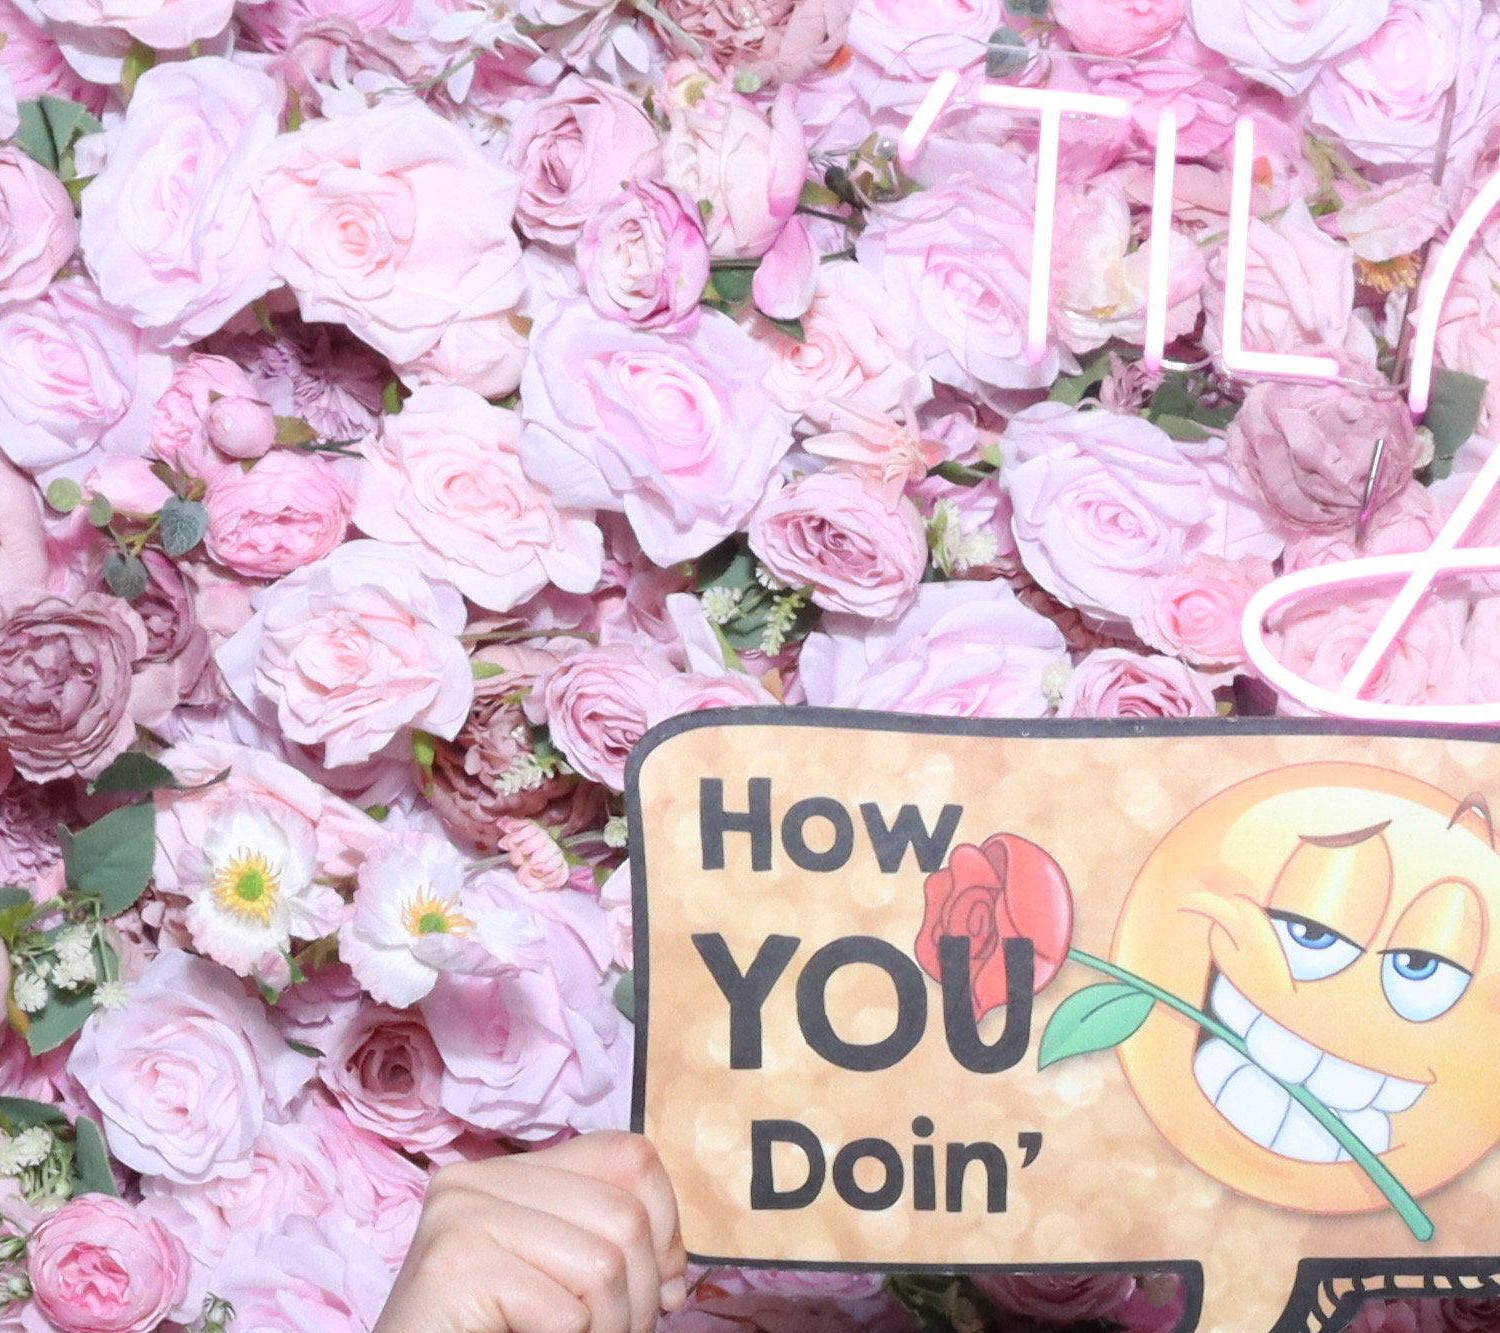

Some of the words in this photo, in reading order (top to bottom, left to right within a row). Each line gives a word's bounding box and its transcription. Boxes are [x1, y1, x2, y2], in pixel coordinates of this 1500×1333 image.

[698, 776, 964, 874] How
[689, 931, 1036, 1075] YOU
[749, 1115, 1044, 1214] Doin'
